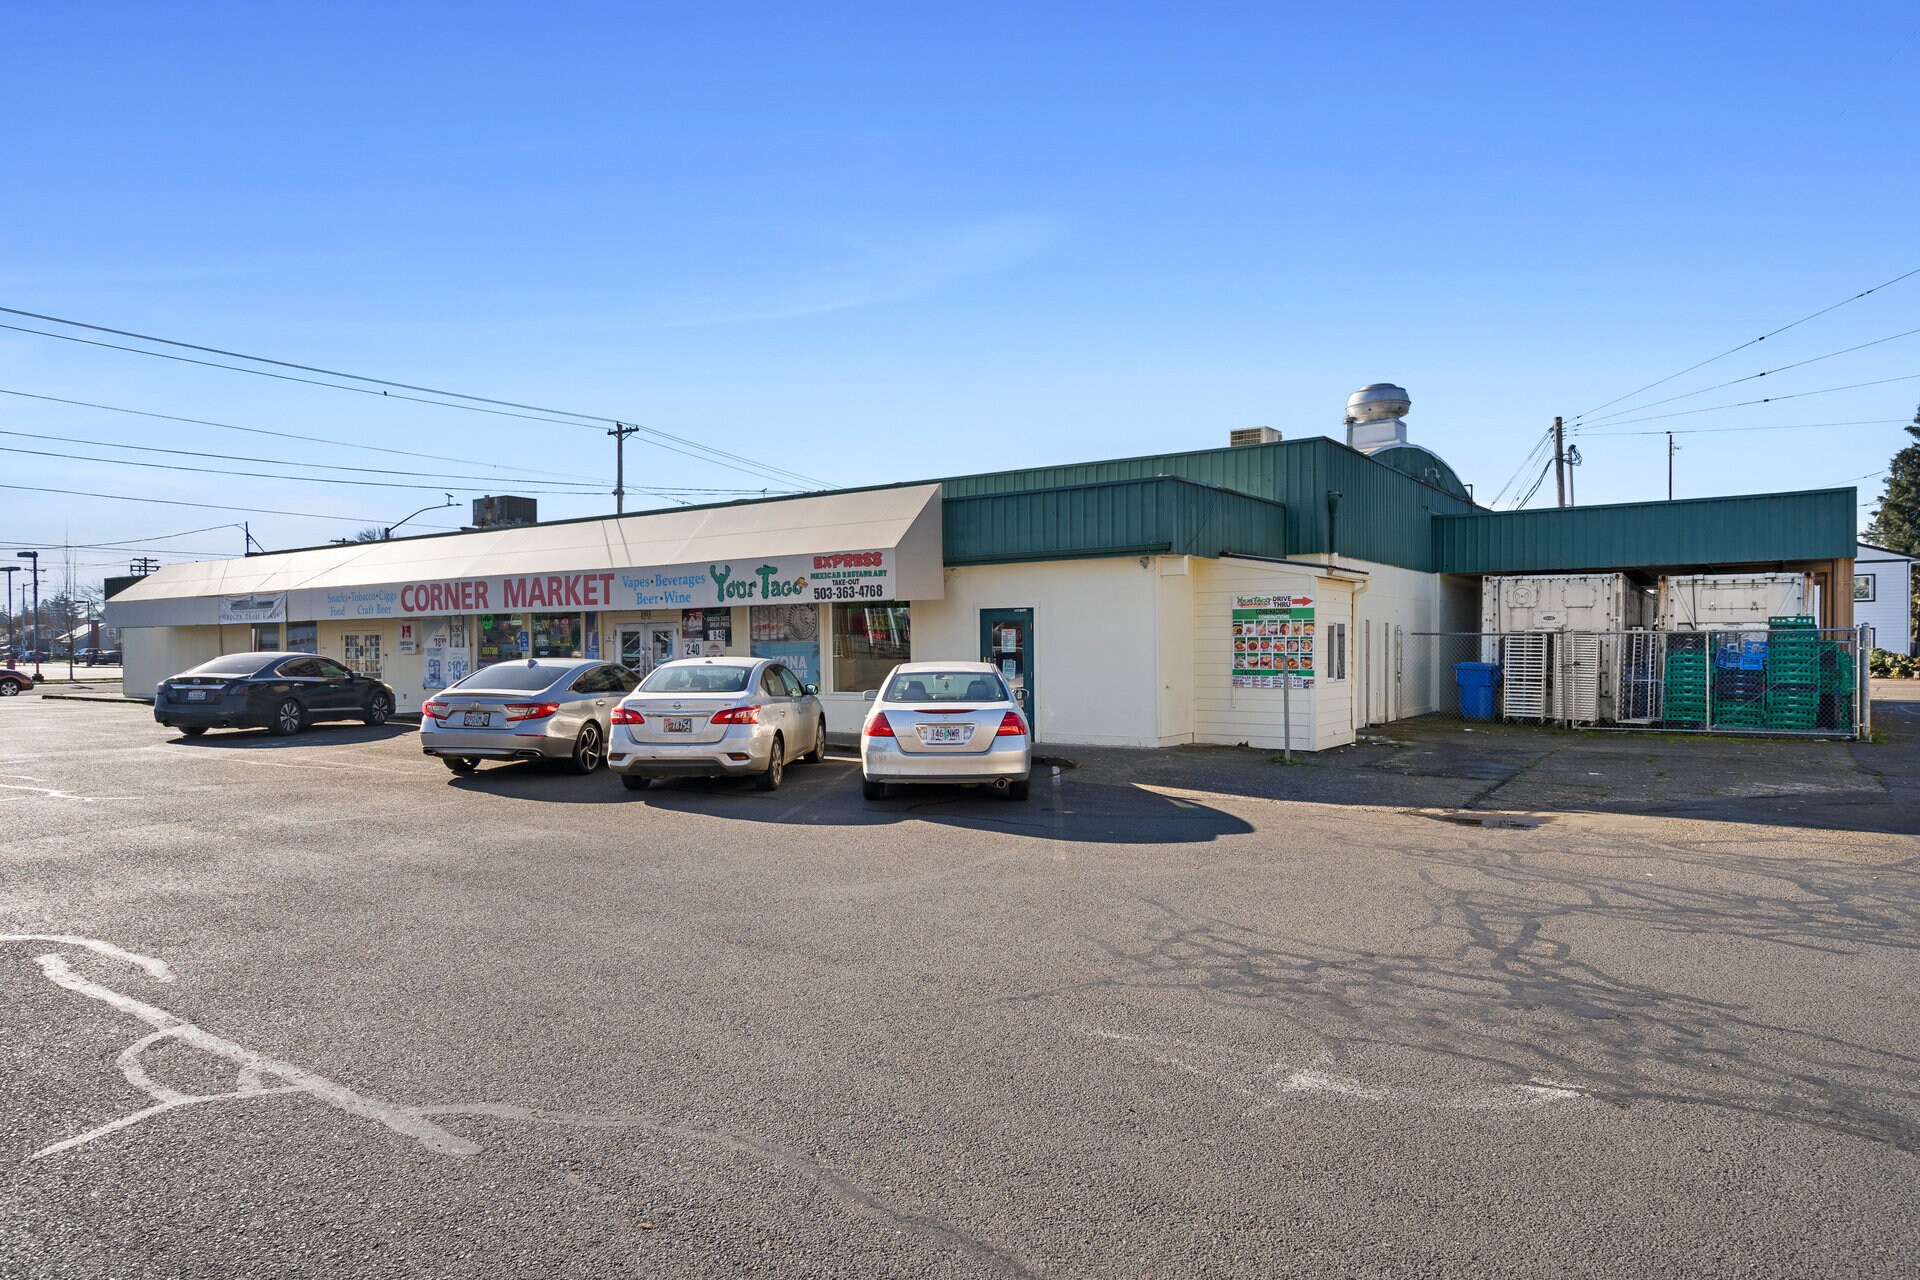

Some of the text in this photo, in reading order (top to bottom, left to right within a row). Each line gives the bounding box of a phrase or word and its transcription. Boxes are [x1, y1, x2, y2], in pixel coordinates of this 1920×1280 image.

[813, 551, 883, 569] EXPRESS
[810, 569, 887, 580] MEXICAN RESTAURANT
[621, 574, 706, 591] Vapes Beverages
[709, 564, 757, 602] Your
[832, 578, 860, 586] TAKE-OUT
[327, 590, 398, 603] Snacks Tobacco Ciggs
[400, 573, 615, 613] CORNER MARKET
[636, 591, 691, 605] Beer Wine
[813, 584, 883, 600] 503-363-4768
[330, 603, 392, 616] Food Craft Beer
[931, 728, 960, 738] 146 NWR
